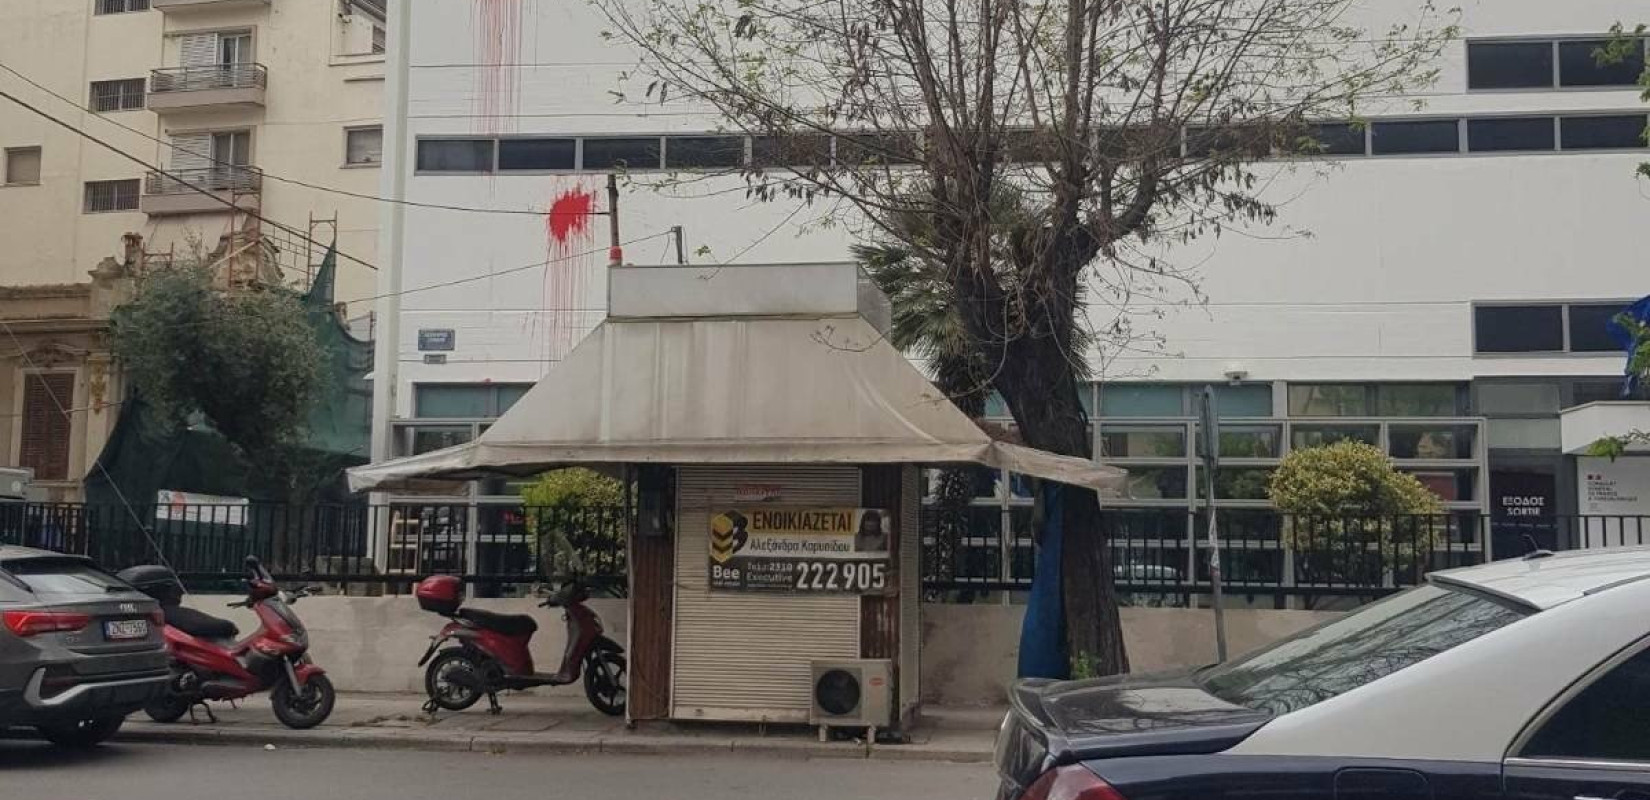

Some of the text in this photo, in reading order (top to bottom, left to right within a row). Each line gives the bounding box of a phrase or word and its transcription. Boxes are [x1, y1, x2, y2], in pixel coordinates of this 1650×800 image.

[1502, 496, 1545, 506] ΕΞΟΔΟΣ
[1507, 507, 1541, 516] SORTIE
[752, 510, 852, 532] ΕΝΟΙΚΙΑΖΕΤΑΙ
[712, 564, 741, 579] Bee
[747, 572, 793, 582] Executive
